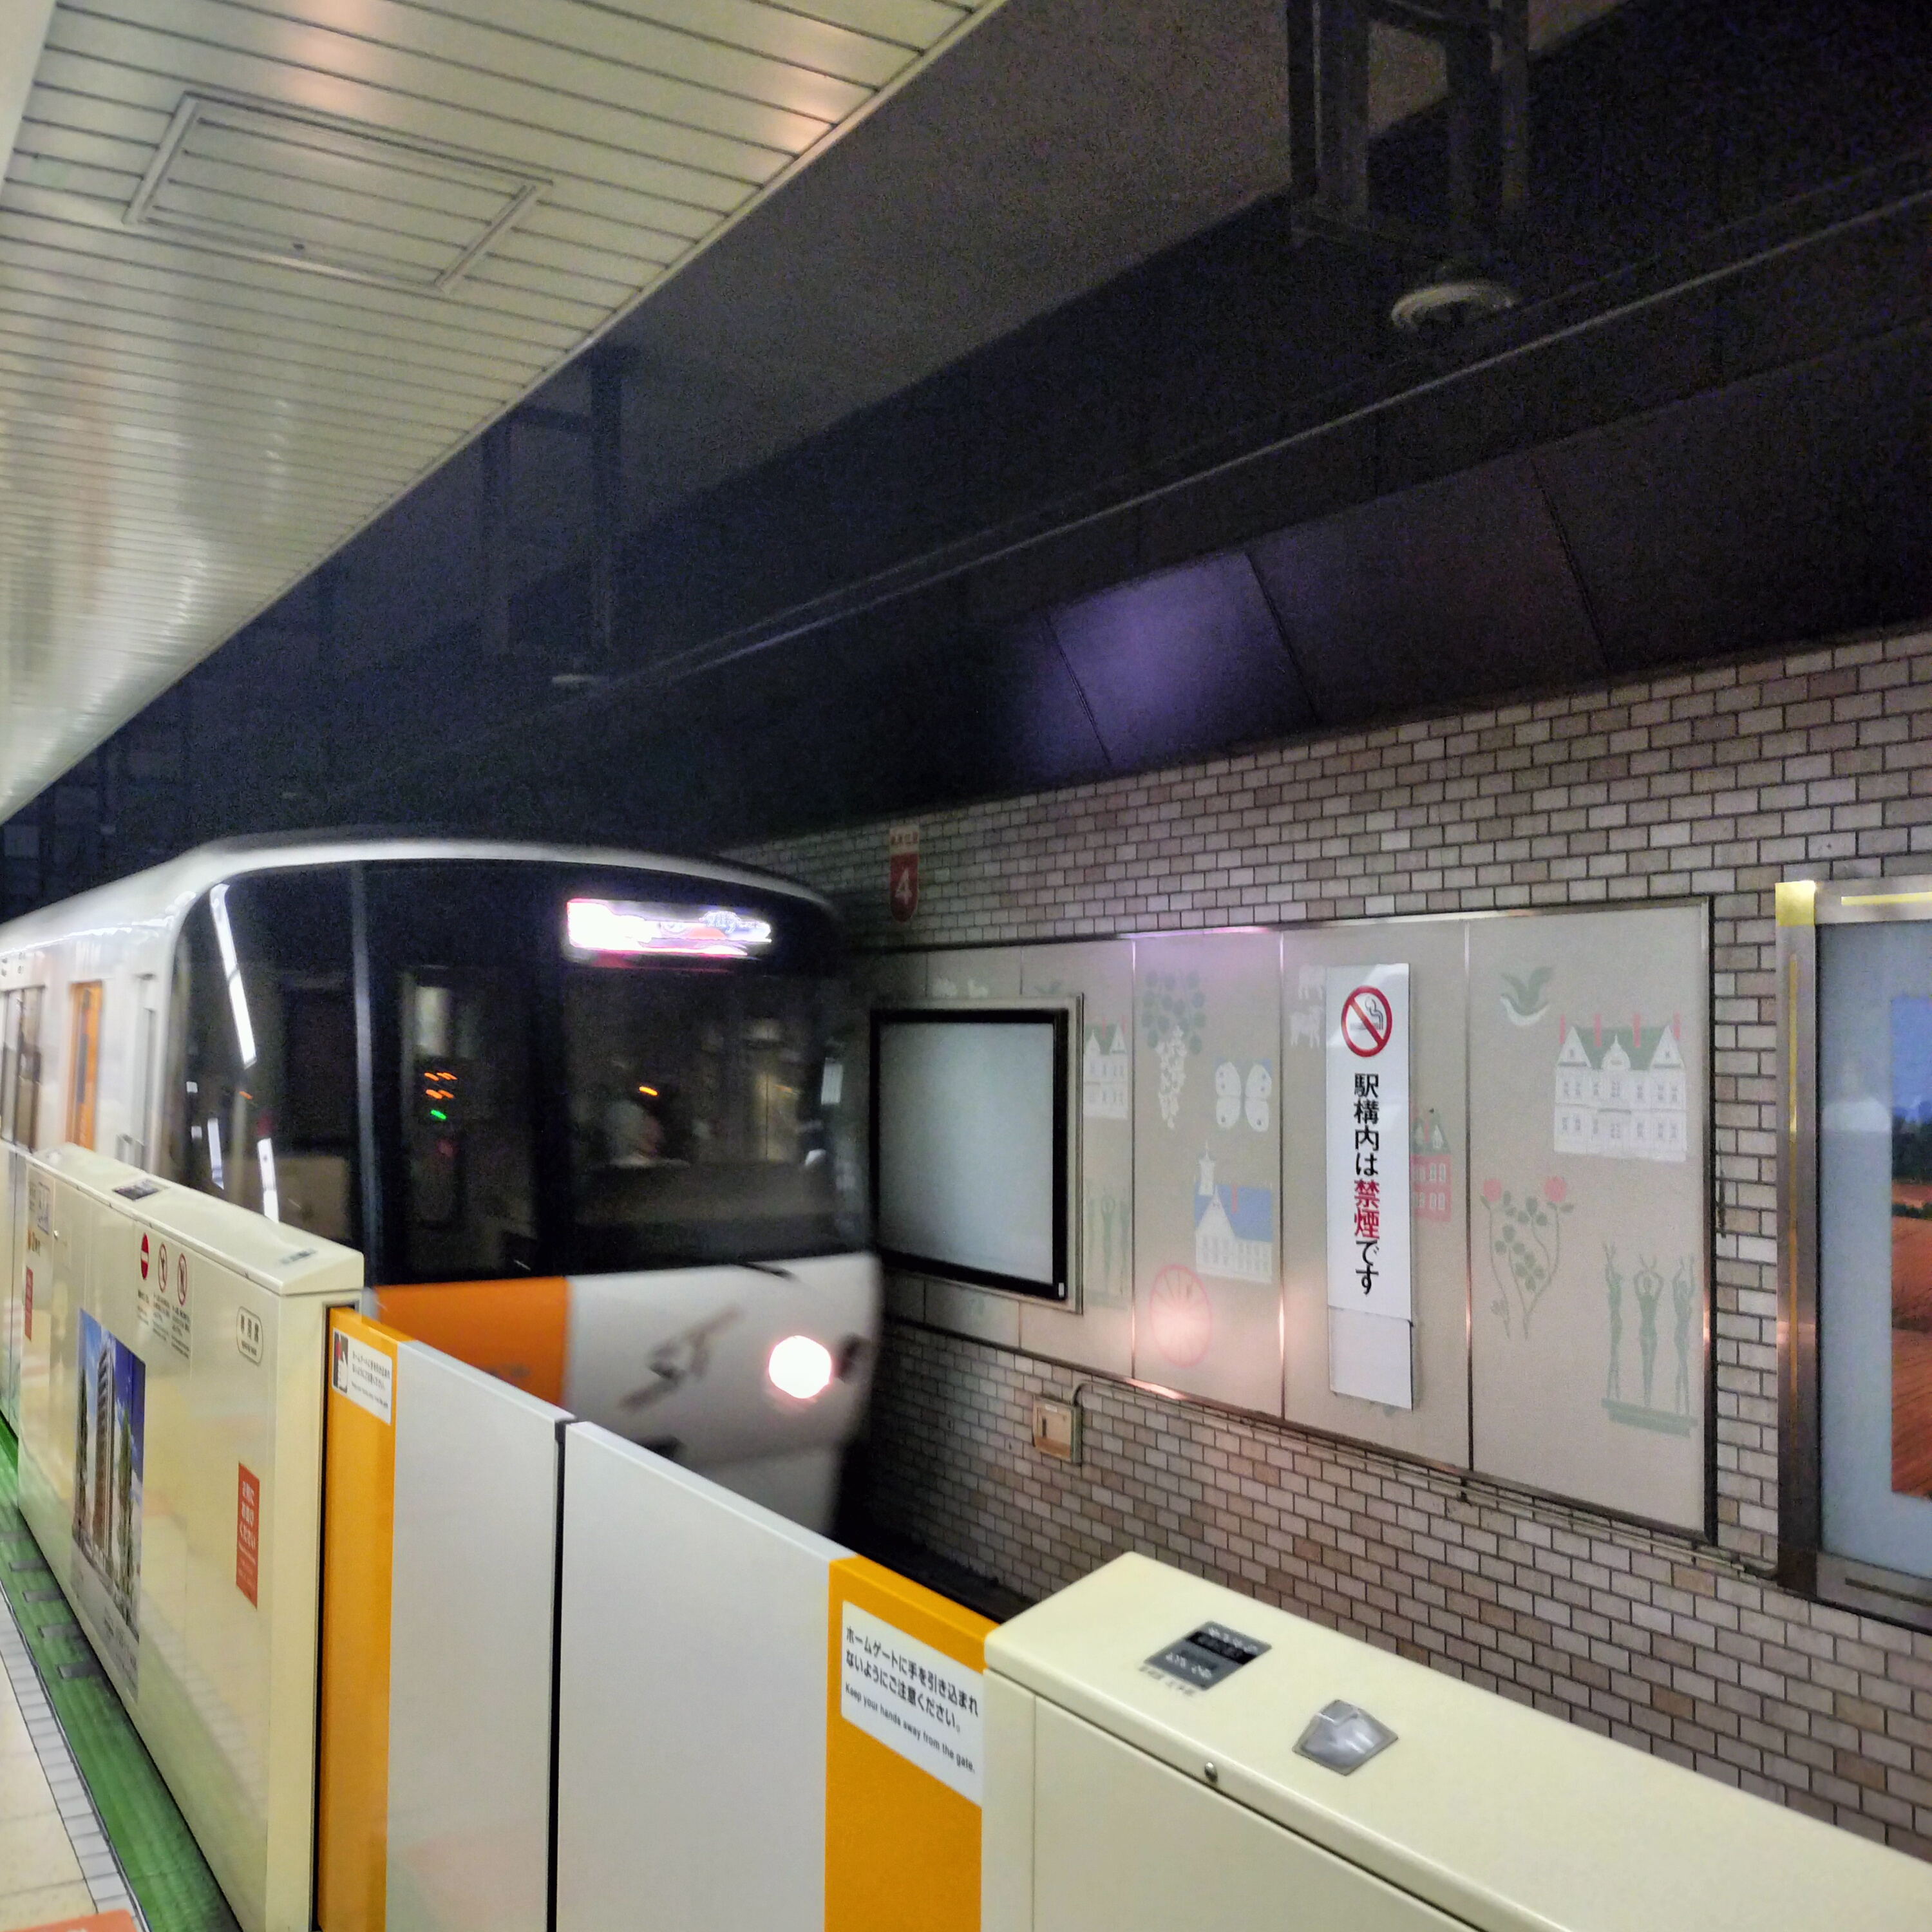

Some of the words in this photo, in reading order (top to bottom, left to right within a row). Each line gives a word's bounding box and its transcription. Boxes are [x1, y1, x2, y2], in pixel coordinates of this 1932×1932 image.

[895, 868, 913, 905] 4
[1354, 1072, 1380, 1296] 駅構内は禁煙です
[846, 1626, 979, 1718] ホームゲートに手を引き込まれ
[846, 1649, 961, 1734] ないようにご注意ください。
[845, 1681, 862, 1703] Keep
[864, 1694, 878, 1712] your
[880, 1703, 902, 1727] hands
[903, 1720, 921, 1741] away
[923, 1730, 940, 1750] from
[942, 1743, 954, 1760] the
[956, 1752, 976, 1774] gate.
